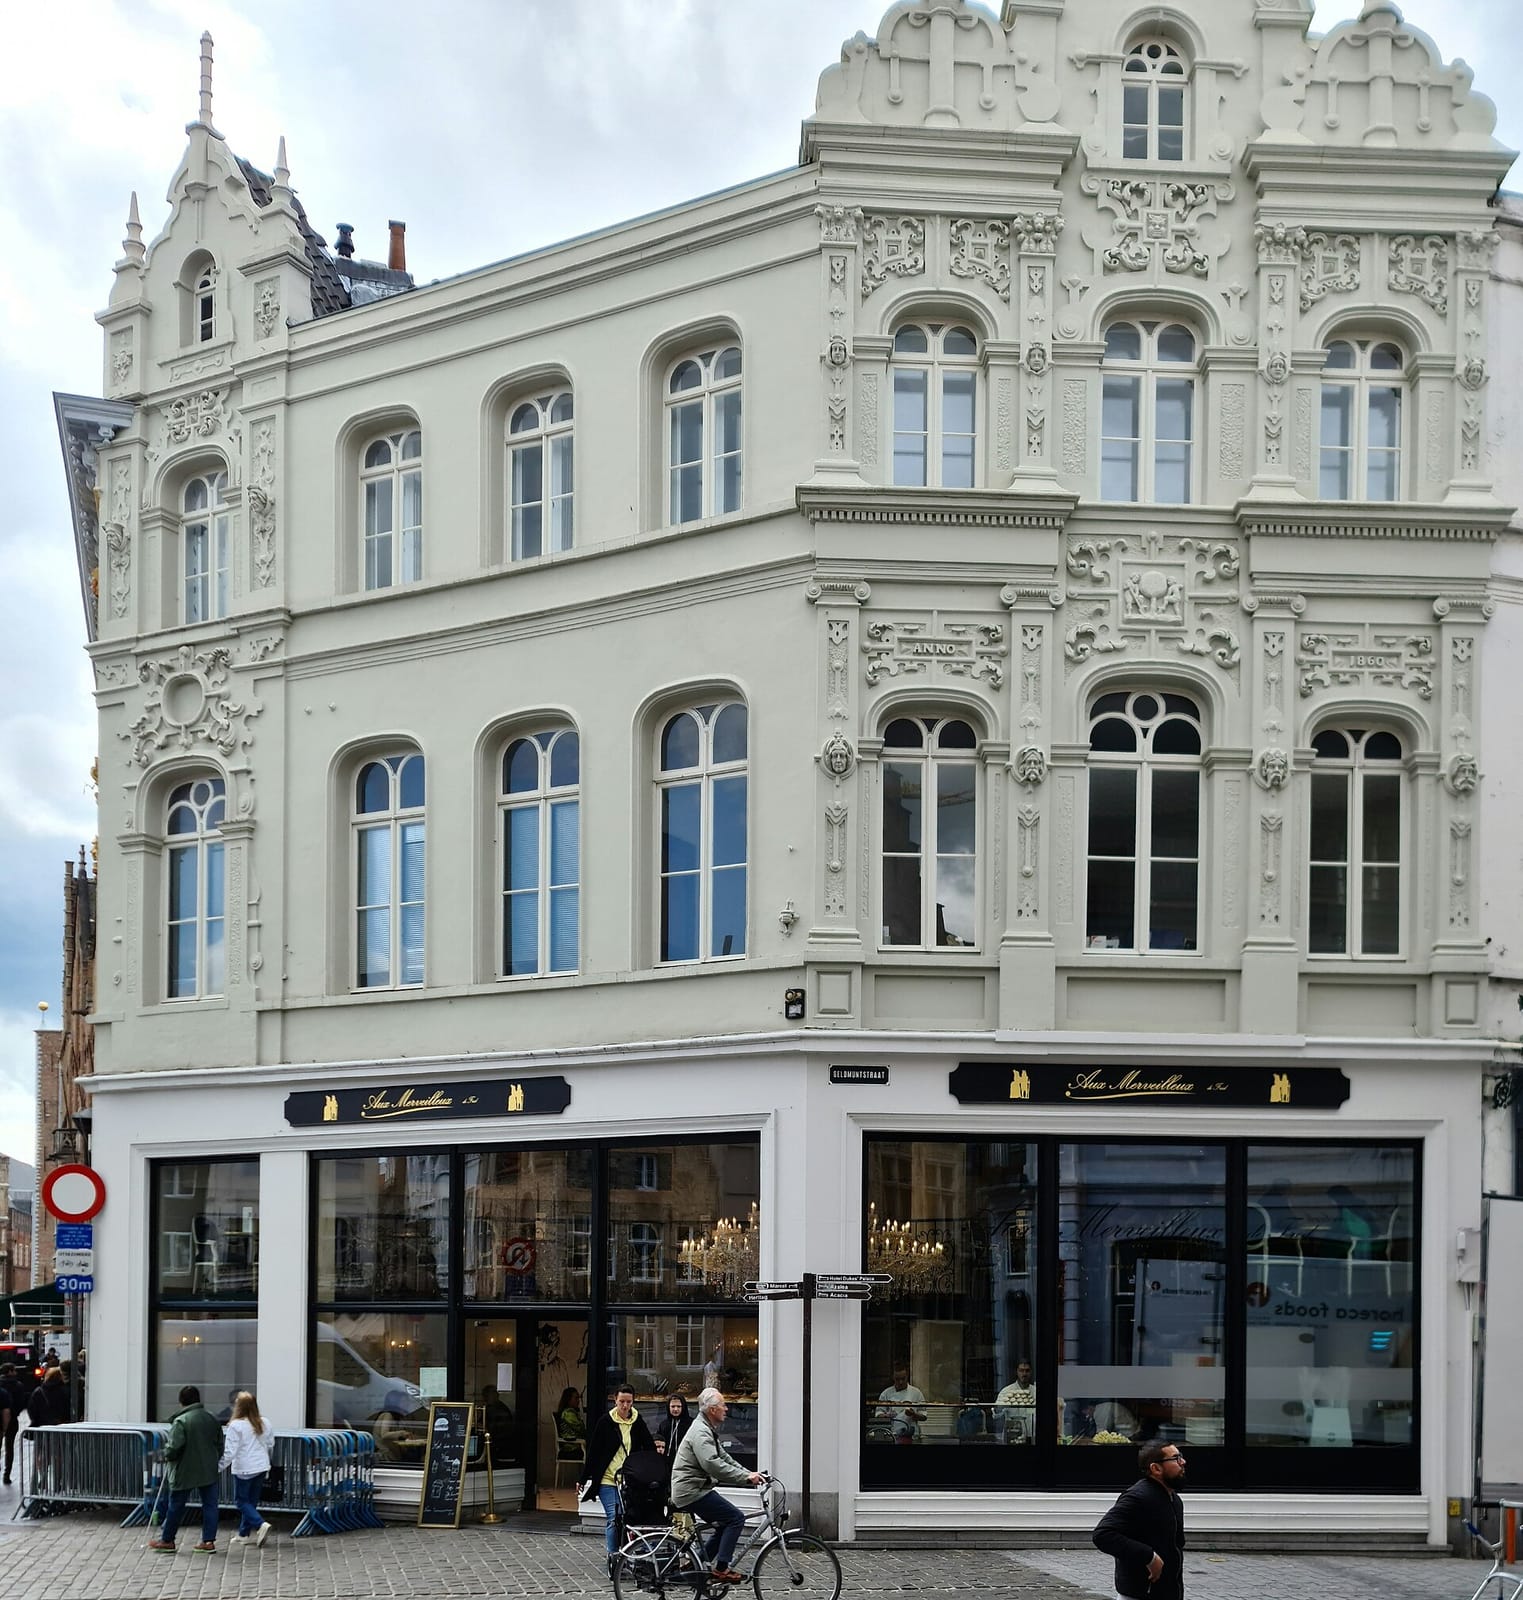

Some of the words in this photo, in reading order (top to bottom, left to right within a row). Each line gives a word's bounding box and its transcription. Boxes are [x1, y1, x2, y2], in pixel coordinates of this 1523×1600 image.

[913, 642, 956, 654] ANNO
[1350, 655, 1385, 666] 1860
[1067, 1068, 1107, 1090] Aux
[1109, 1069, 1195, 1091] Merveilleux
[363, 1089, 390, 1110] Aux
[391, 1088, 453, 1108] Merveilleux
[58, 1278, 91, 1290] 30m
